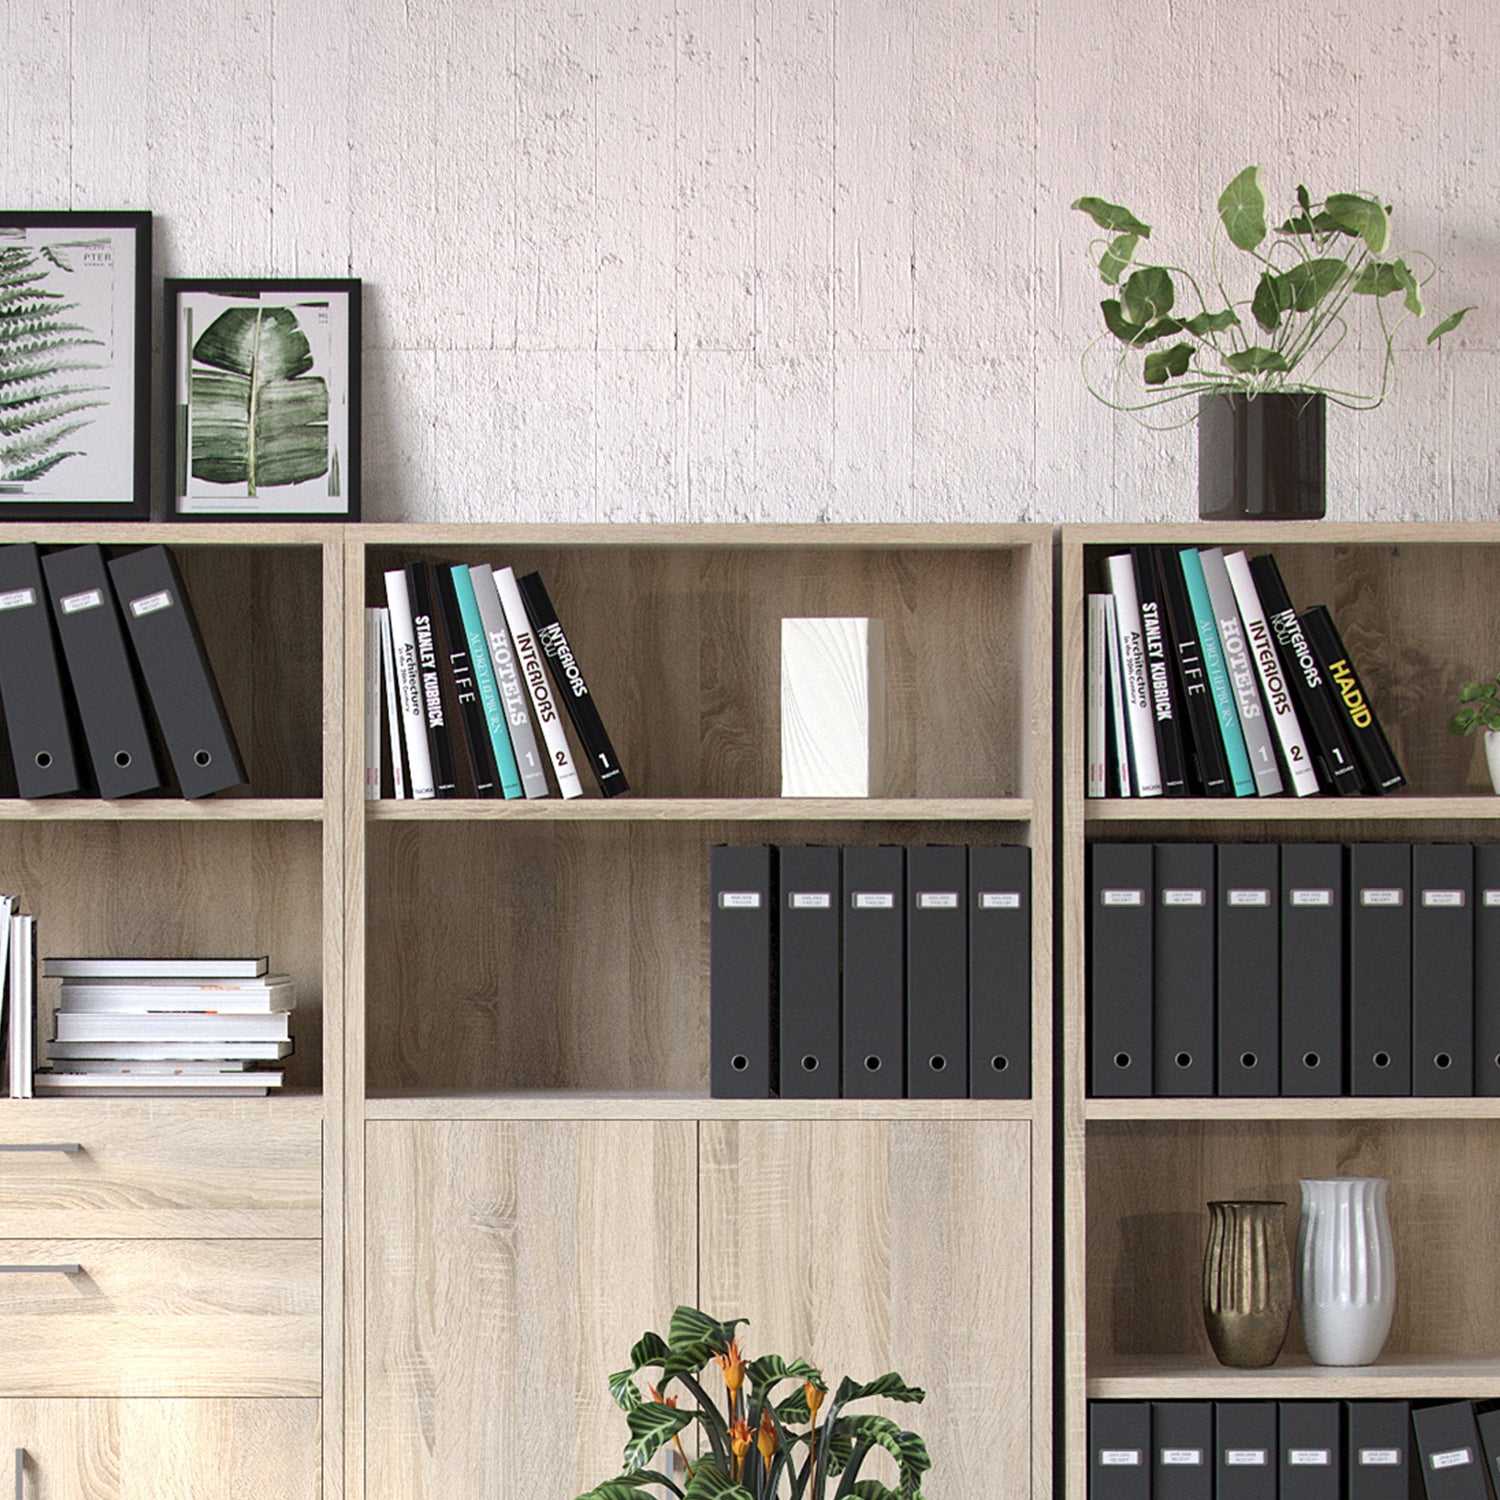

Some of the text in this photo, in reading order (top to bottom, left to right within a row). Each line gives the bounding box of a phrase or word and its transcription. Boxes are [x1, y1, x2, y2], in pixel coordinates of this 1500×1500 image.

[538, 628, 556, 657] NOW
[547, 622, 588, 698] INTERIORS
[1142, 602, 1173, 722] STANLEY KUBRICK
[1271, 615, 1290, 645] NOW
[1280, 609, 1322, 689] INTERIORS
[404, 643, 420, 716] Architecture
[415, 615, 444, 729] STANLEY KUBRICK
[450, 652, 475, 704] LIFE
[470, 632, 503, 734] AUDREY HEPBURN
[489, 629, 527, 726] HOTELS
[516, 632, 556, 724] INTERIORS
[1130, 631, 1148, 708] Architecture
[1179, 641, 1206, 697] LIFE
[1200, 620, 1235, 728] AUDREY HEPBURN
[1220, 619, 1260, 719] HOTELS
[1249, 620, 1291, 716] INTERIORS
[1328, 659, 1373, 729] HADID
[525, 752, 534, 767] 1
[555, 751, 568, 766] 2
[598, 753, 610, 768] 1
[1258, 746, 1268, 762] 1
[1289, 746, 1303, 762] 2
[1332, 748, 1344, 764] 1
